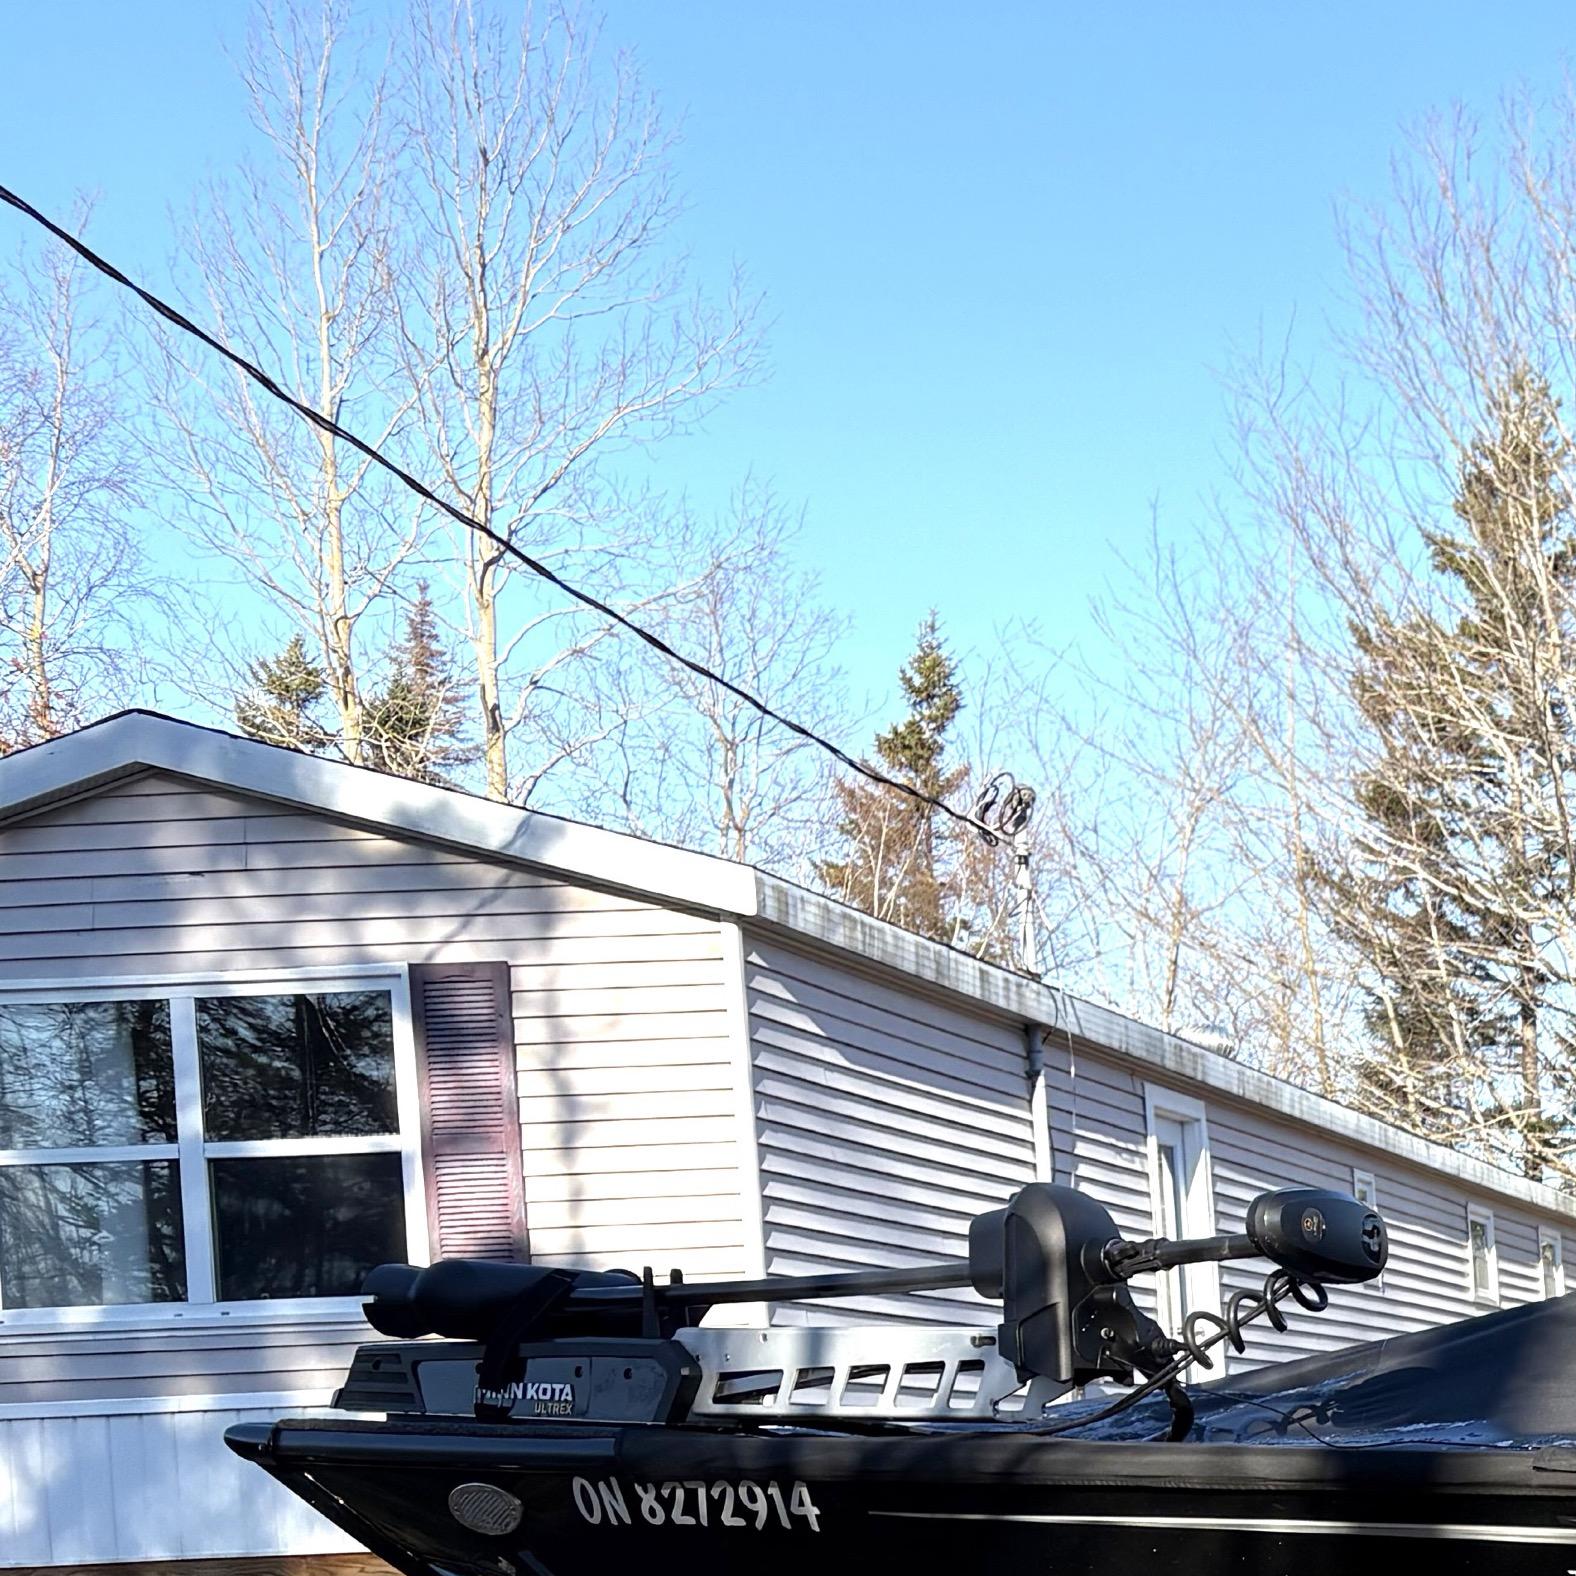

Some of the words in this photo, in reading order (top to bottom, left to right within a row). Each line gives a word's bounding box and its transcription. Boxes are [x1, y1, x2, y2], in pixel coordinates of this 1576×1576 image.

[527, 1382, 573, 1401] KOTA
[534, 1402, 573, 1415] ULTREX
[572, 1476, 632, 1526] ON
